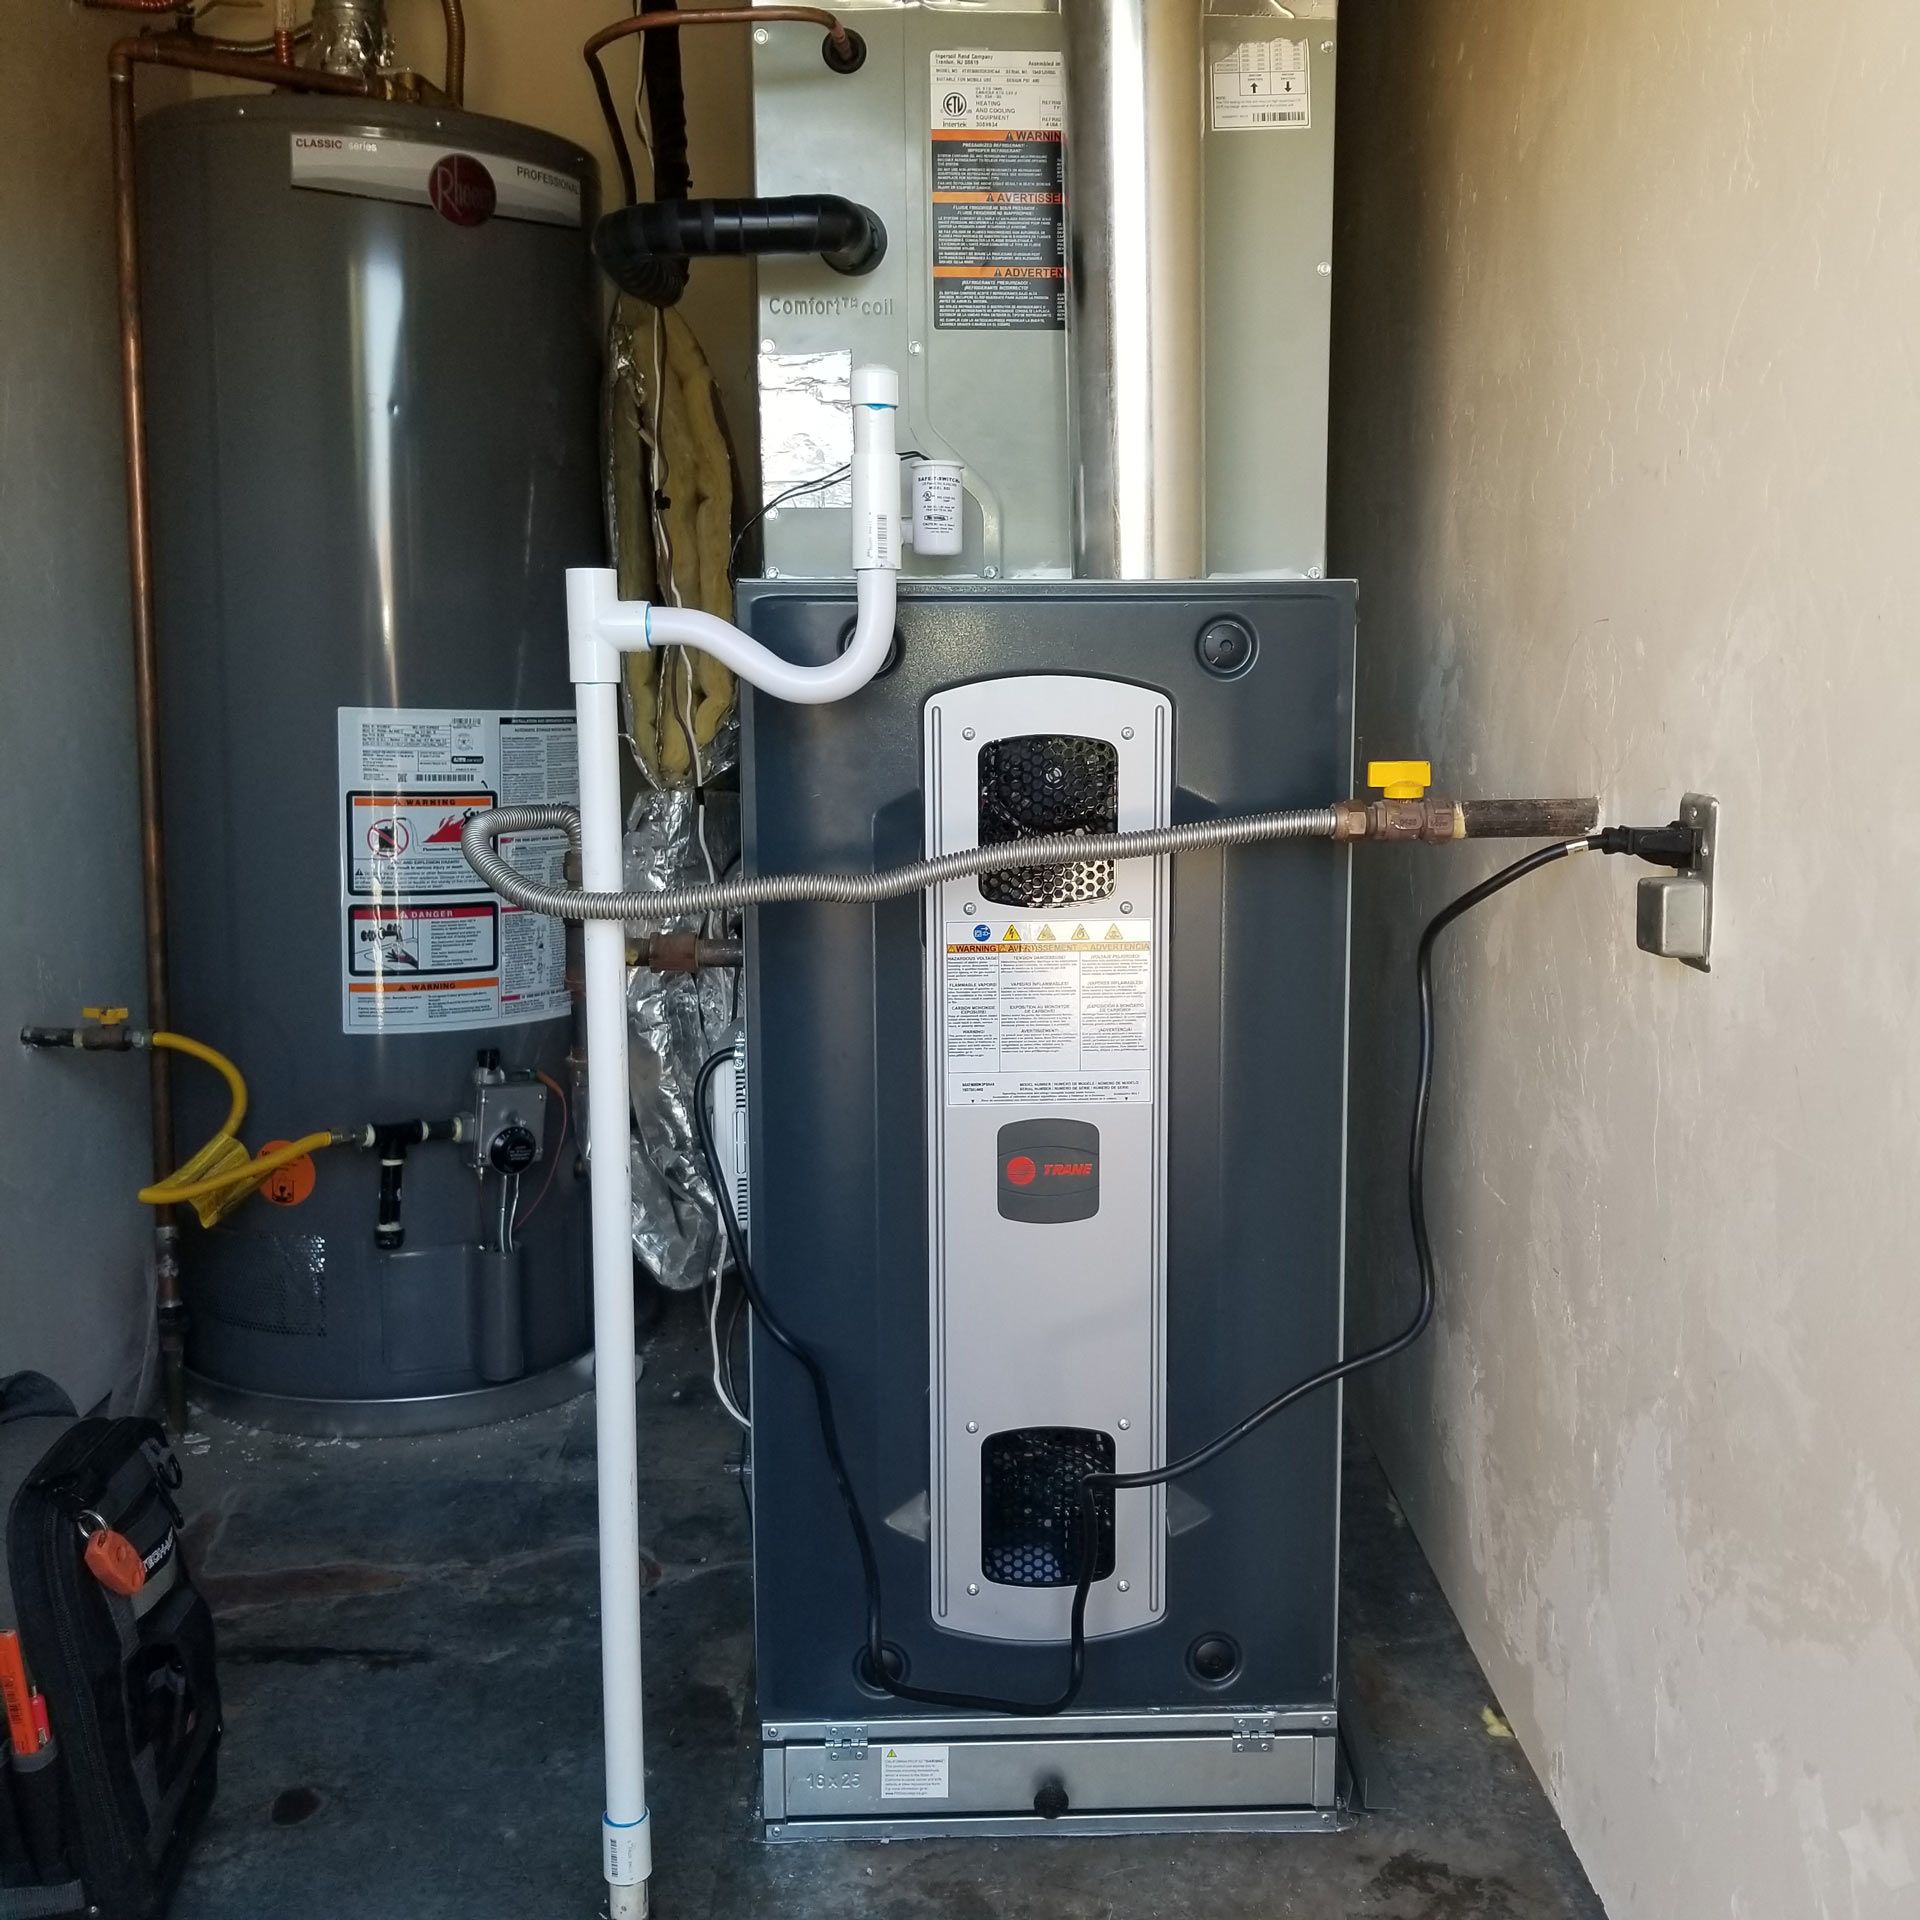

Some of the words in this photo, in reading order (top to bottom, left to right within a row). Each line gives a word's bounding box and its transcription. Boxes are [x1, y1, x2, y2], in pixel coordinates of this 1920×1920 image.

[1016, 131, 1062, 141] WARNIN
[295, 138, 343, 149] CLASSIC
[348, 142, 377, 152] series
[516, 165, 580, 195] PROFESSIONAL
[997, 193, 1063, 203] AVERTISSE
[1005, 268, 1064, 278] ADVERTEN
[861, 298, 893, 316] coil
[411, 910, 453, 919] DANGER
[956, 945, 997, 953] WARNING
[1090, 943, 1150, 951] ADVERTENCIA
[412, 982, 456, 991] WARNING
[1043, 1163, 1093, 1177] TRANE
[806, 1772, 825, 1789] 16
[841, 1772, 861, 1789] 25
